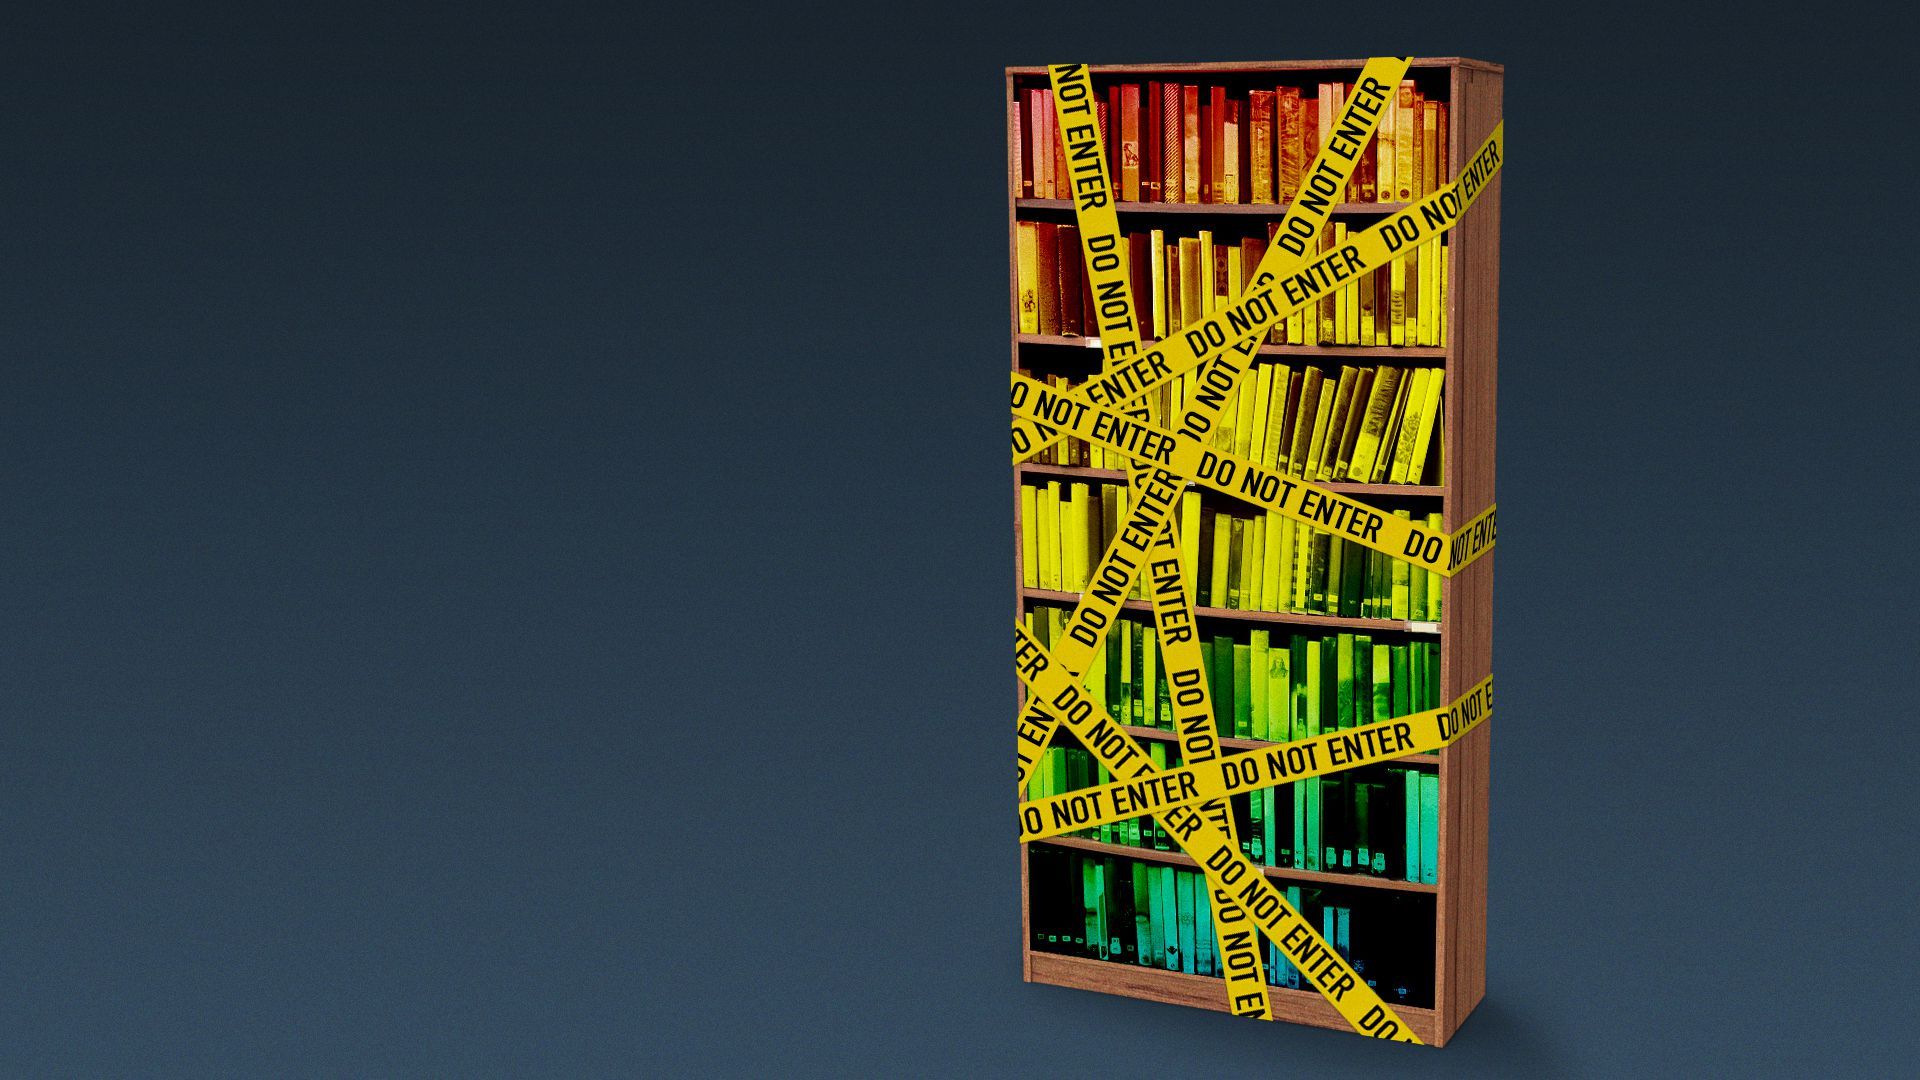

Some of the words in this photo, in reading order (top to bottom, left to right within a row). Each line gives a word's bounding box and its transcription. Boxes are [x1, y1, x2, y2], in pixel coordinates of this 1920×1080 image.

[1055, 64, 1091, 115] NOT
[1066, 124, 1107, 212] ENTER
[1277, 216, 1315, 257] DO
[1300, 159, 1344, 216] NOT
[1328, 76, 1390, 161] ENTER
[1379, 214, 1420, 253] DO
[1420, 185, 1462, 231] NOT
[1459, 140, 1500, 200] ENTER
[1088, 234, 1120, 272] DO
[1096, 280, 1136, 333] NOT
[1185, 320, 1226, 358] DO
[1225, 288, 1279, 336] NOT
[1281, 244, 1366, 306] ENTER
[1012, 427, 1031, 454] O
[1085, 350, 1172, 407] ENTER
[1195, 354, 1240, 411] NOT
[1011, 381, 1029, 408] O
[1033, 389, 1090, 430] NOT
[1091, 411, 1176, 465] ENTER
[1196, 451, 1236, 486] DO
[1240, 467, 1297, 508] NOT
[1298, 489, 1383, 543] ENTER
[1070, 607, 1107, 648] DO
[1092, 548, 1136, 607] NOT
[1121, 469, 1183, 552] ENTER
[1403, 529, 1442, 564] DO
[1447, 524, 1473, 570] NOT
[1151, 558, 1192, 646] ENTER
[1172, 668, 1205, 706] DO
[1436, 708, 1458, 742] DO
[1461, 690, 1482, 726] NOT
[1053, 685, 1093, 726] DO
[1085, 718, 1139, 770] NOT
[1181, 714, 1215, 764] NOT
[1221, 757, 1260, 790] DO
[1267, 742, 1317, 780] NOT
[1327, 722, 1414, 766] ENTER
[1051, 791, 1102, 829] NOT
[1111, 771, 1199, 815] ENTER
[1206, 845, 1246, 885] DO
[1238, 878, 1292, 930] NOT
[1281, 924, 1355, 1002] ENTER
[1223, 931, 1259, 983] NOT
[1358, 1004, 1399, 1039] DO
